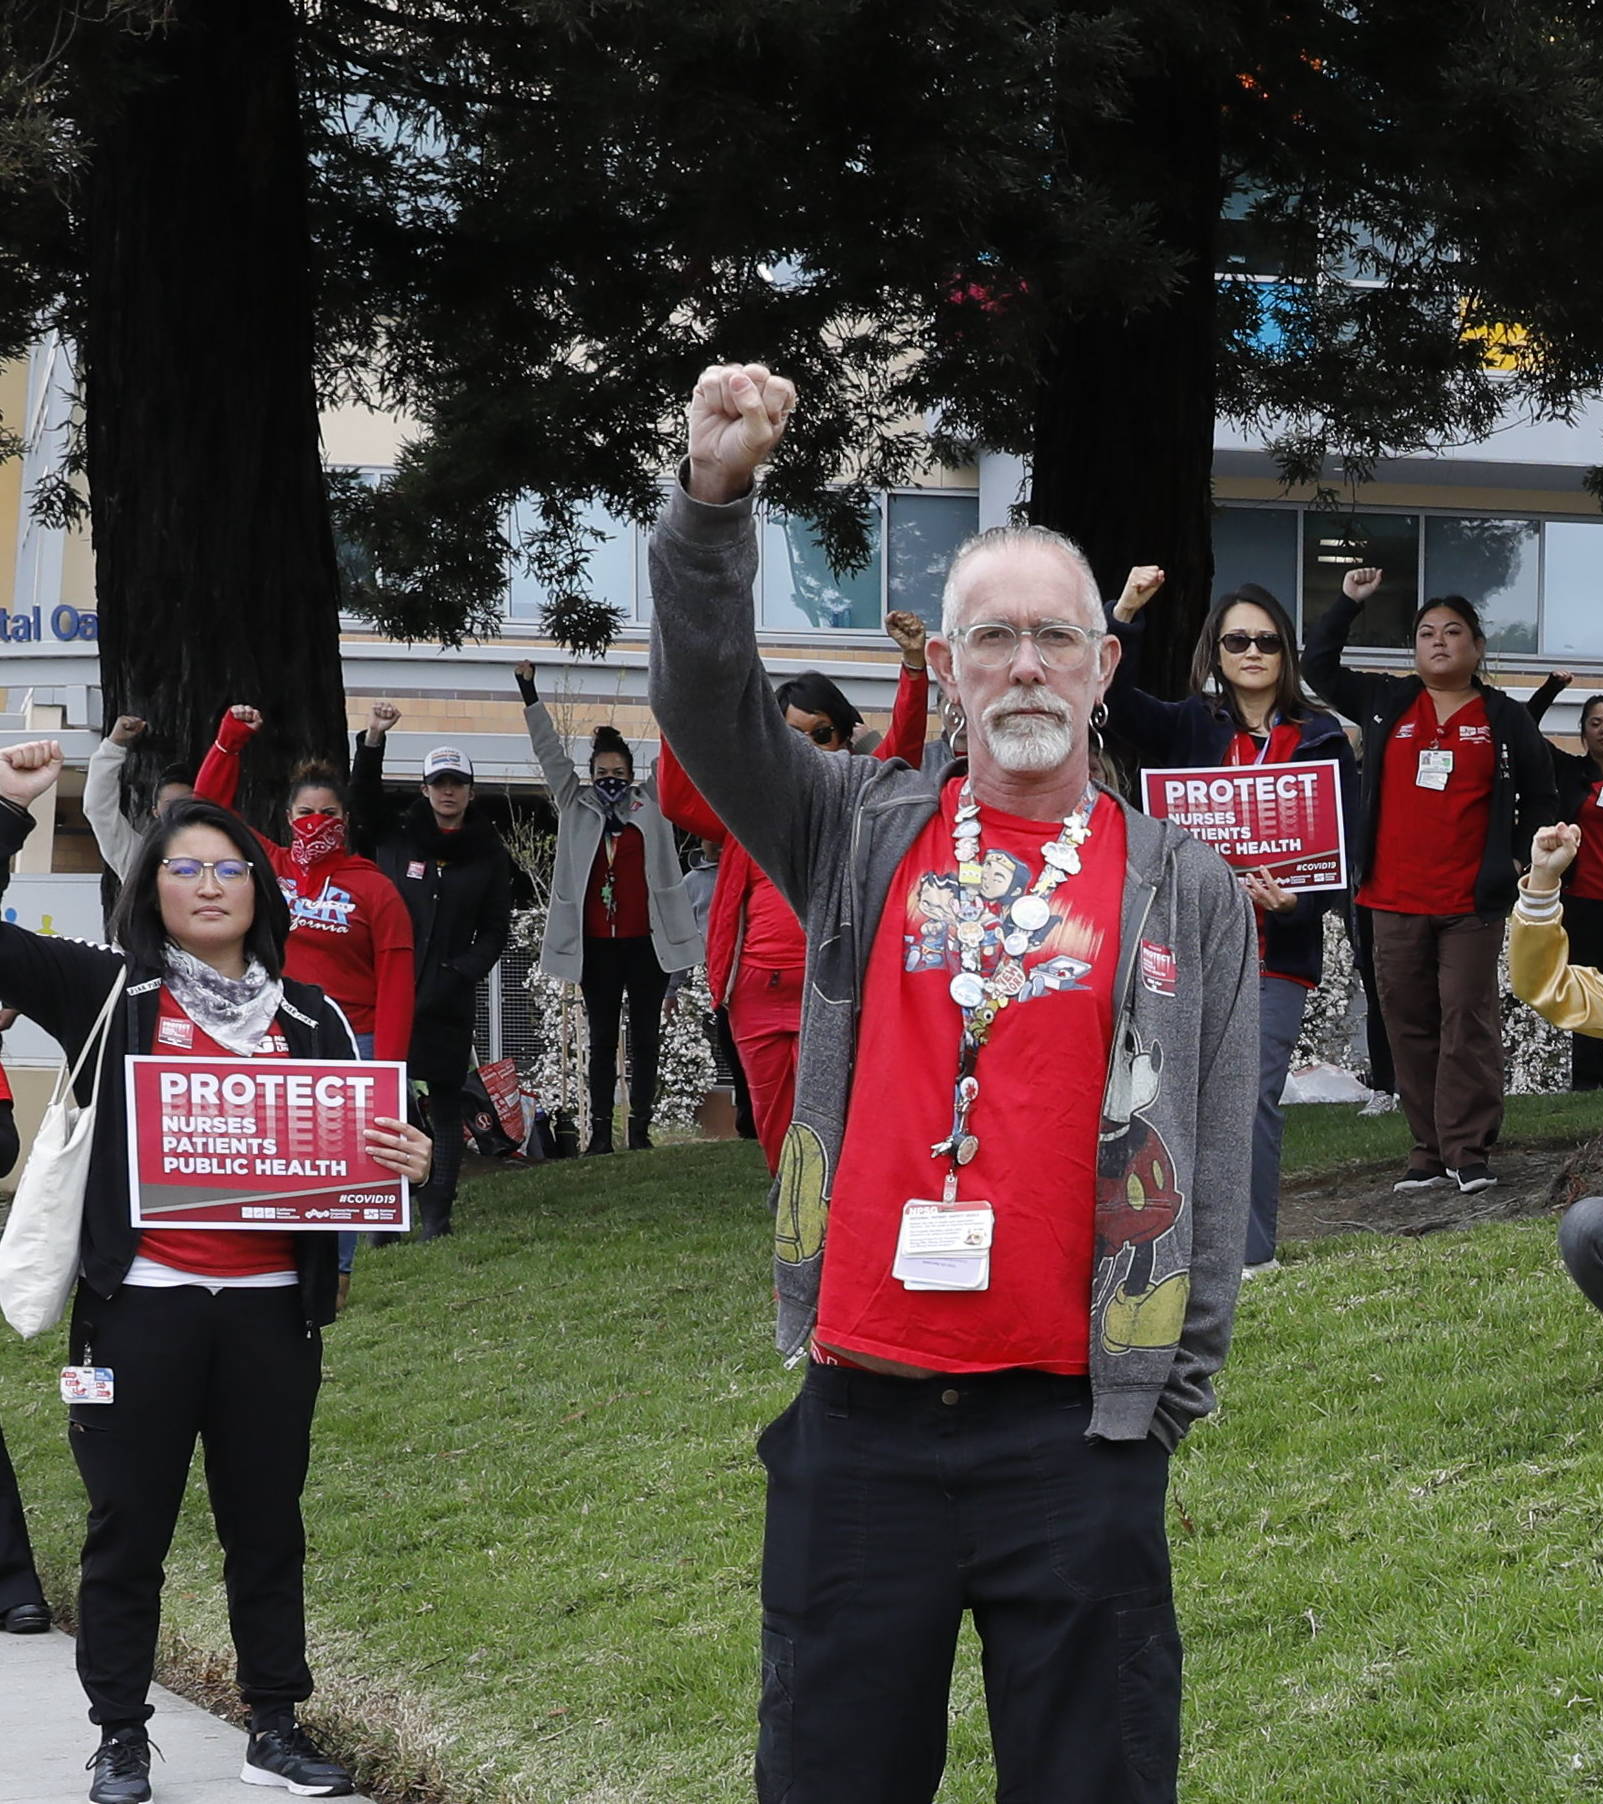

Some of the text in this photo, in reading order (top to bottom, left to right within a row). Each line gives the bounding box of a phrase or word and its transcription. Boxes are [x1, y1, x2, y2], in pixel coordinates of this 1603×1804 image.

[1165, 773, 1318, 804] PROTECT
[1183, 826, 1251, 840] TIENTS
[1237, 838, 1301, 855] HEALTH
[1296, 861, 1336, 872] #COVID19
[160, 1072, 375, 1107] PROTECT
[162, 1116, 256, 1134] NURSES
[163, 1137, 277, 1155] PATIENTS
[164, 1157, 347, 1177] PUBLIC HEALTH
[339, 1194, 396, 1204] #COVID19
